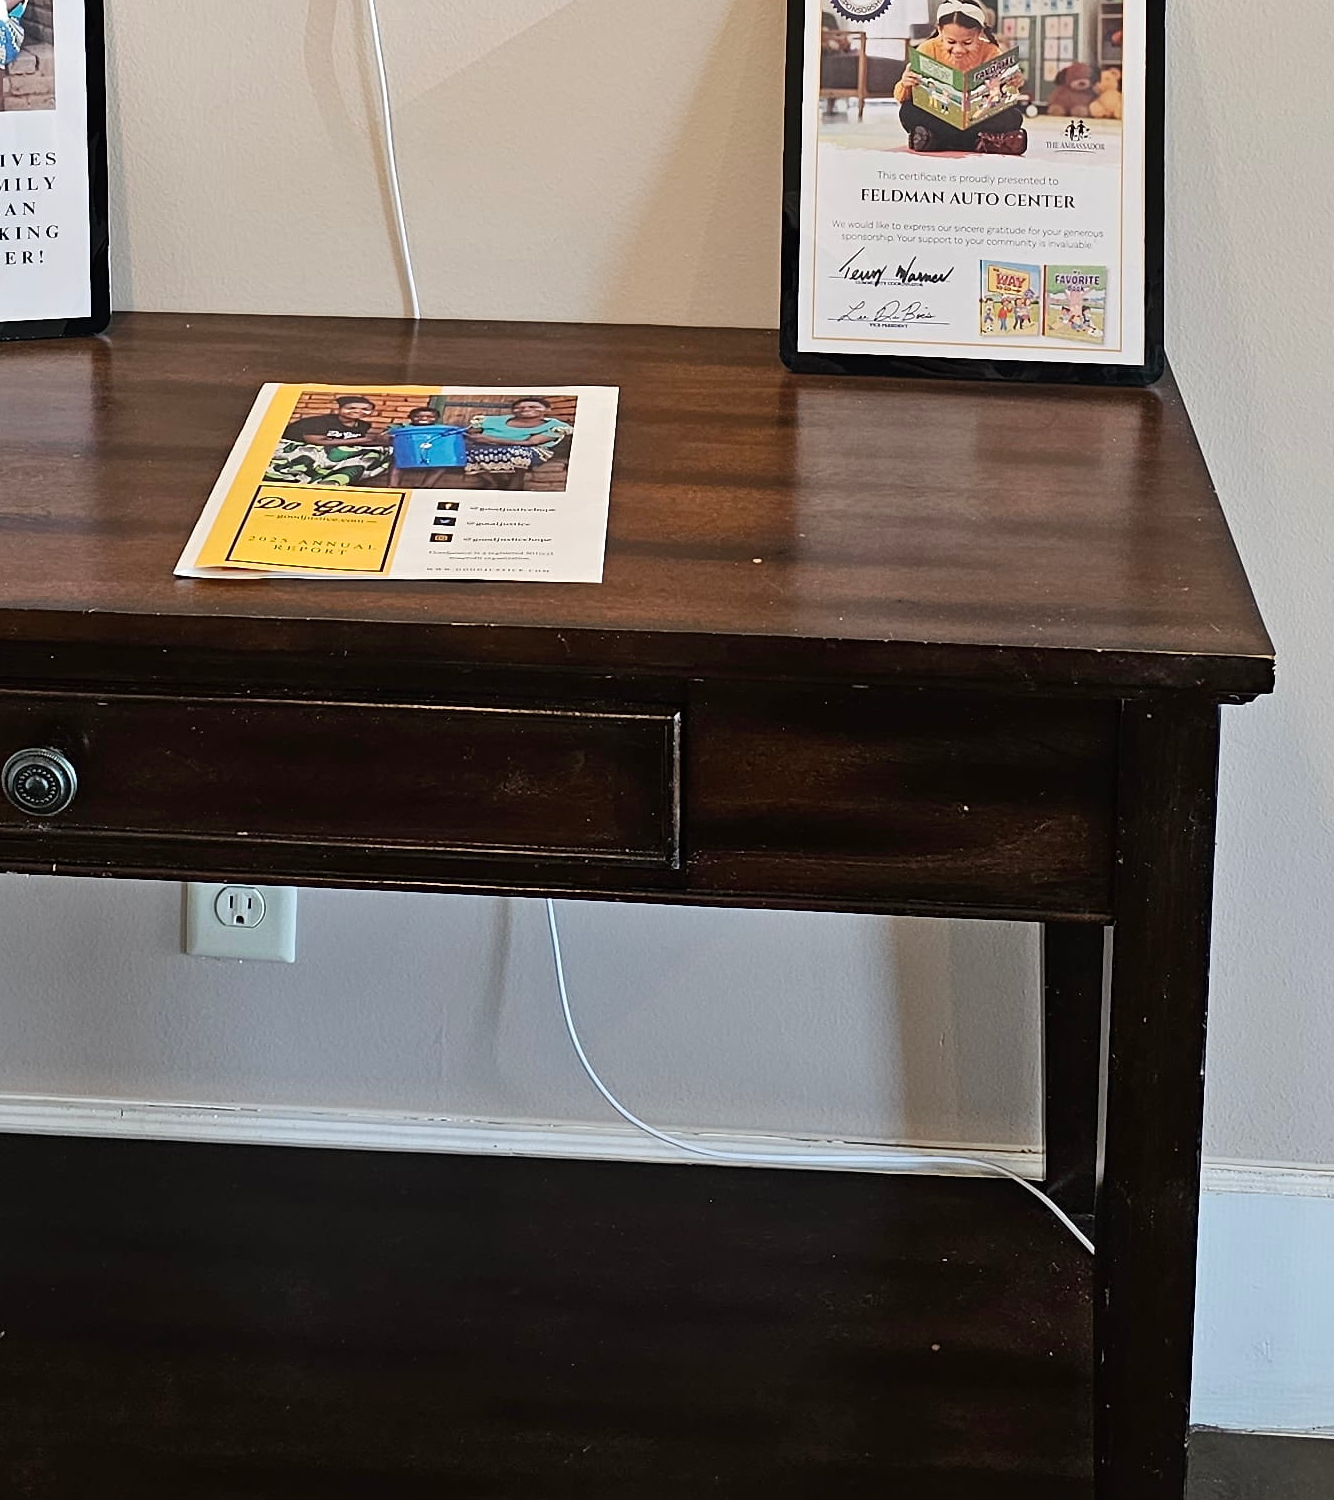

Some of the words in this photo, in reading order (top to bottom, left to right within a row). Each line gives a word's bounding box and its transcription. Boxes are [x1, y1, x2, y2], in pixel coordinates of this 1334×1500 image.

[877, 171, 897, 181] This
[899, 172, 947, 183] certificate
[949, 173, 957, 182] is
[959, 174, 996, 185] proudly
[998, 176, 1046, 187] presented
[1048, 177, 1059, 186] to
[861, 188, 945, 204] FELDMAN
[949, 191, 1000, 206] AUTO
[1004, 193, 1076, 209] CENTER
[892, 222, 902, 230] to
[1028, 226, 1040, 234] for
[1042, 229, 1061, 237] your
[897, 235, 916, 243] Your
[918, 235, 952, 244] support
[954, 236, 963, 244] to
[965, 238, 985, 246] your
[996, 274, 1027, 288] WAY
[1054, 275, 1100, 285] FAVORITE
[254, 496, 302, 511] Do
[312, 499, 397, 516] Good
[273, 544, 348, 556] REPORT
[298, 539, 378, 551] ANNUAL
